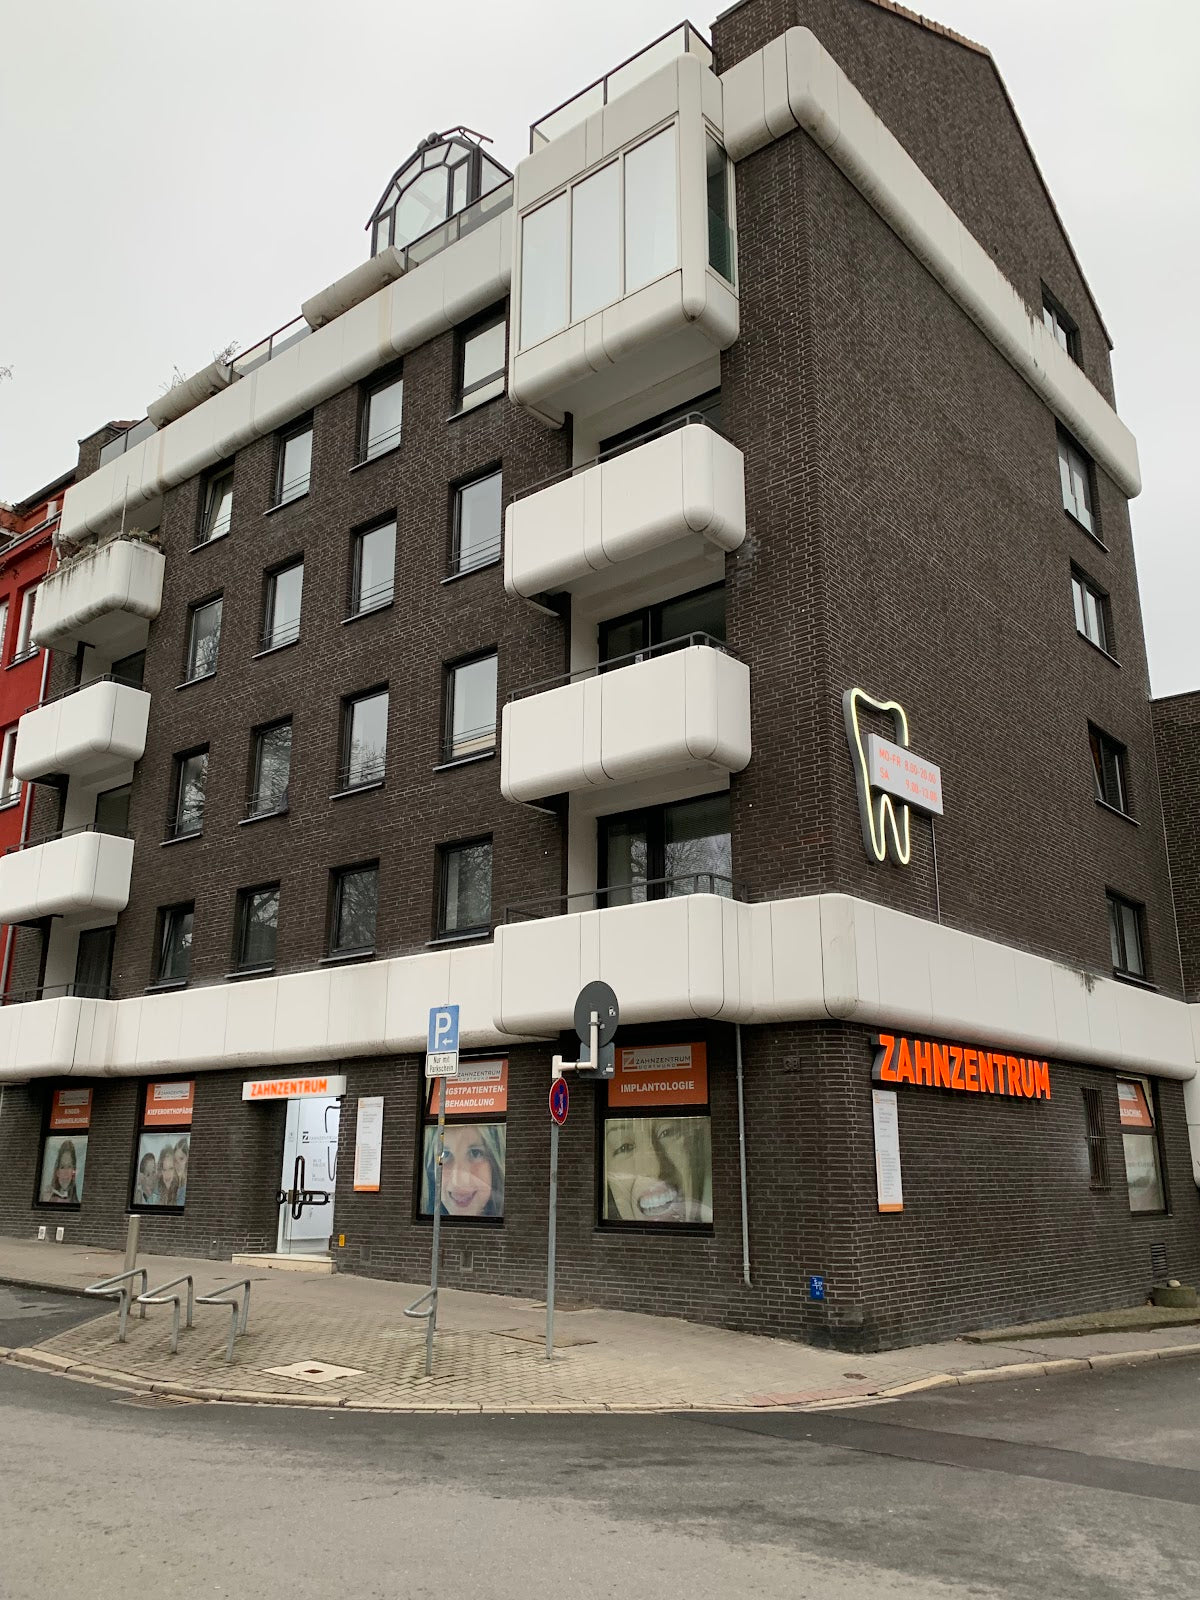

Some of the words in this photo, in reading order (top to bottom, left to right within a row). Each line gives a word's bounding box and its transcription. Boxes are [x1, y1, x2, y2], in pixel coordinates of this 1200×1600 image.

[879, 748, 901, 767] MO-FR
[879, 767, 889, 780] SA
[434, 1012, 452, 1049] P
[433, 1056, 442, 1064] Nur
[442, 1055, 450, 1063] mit
[636, 1055, 691, 1065] ZAHNZENTRUM
[429, 1064, 454, 1073] Parkschein
[879, 1034, 1051, 1099] ZAHNZENTRUM
[457, 1070, 501, 1078] ZAHNZENTRUM
[251, 1079, 327, 1097] ZAHNZENTRUM
[620, 1080, 695, 1093] IMPLANTOLOGIE
[445, 1098, 495, 1108] BEHANDLUNG
